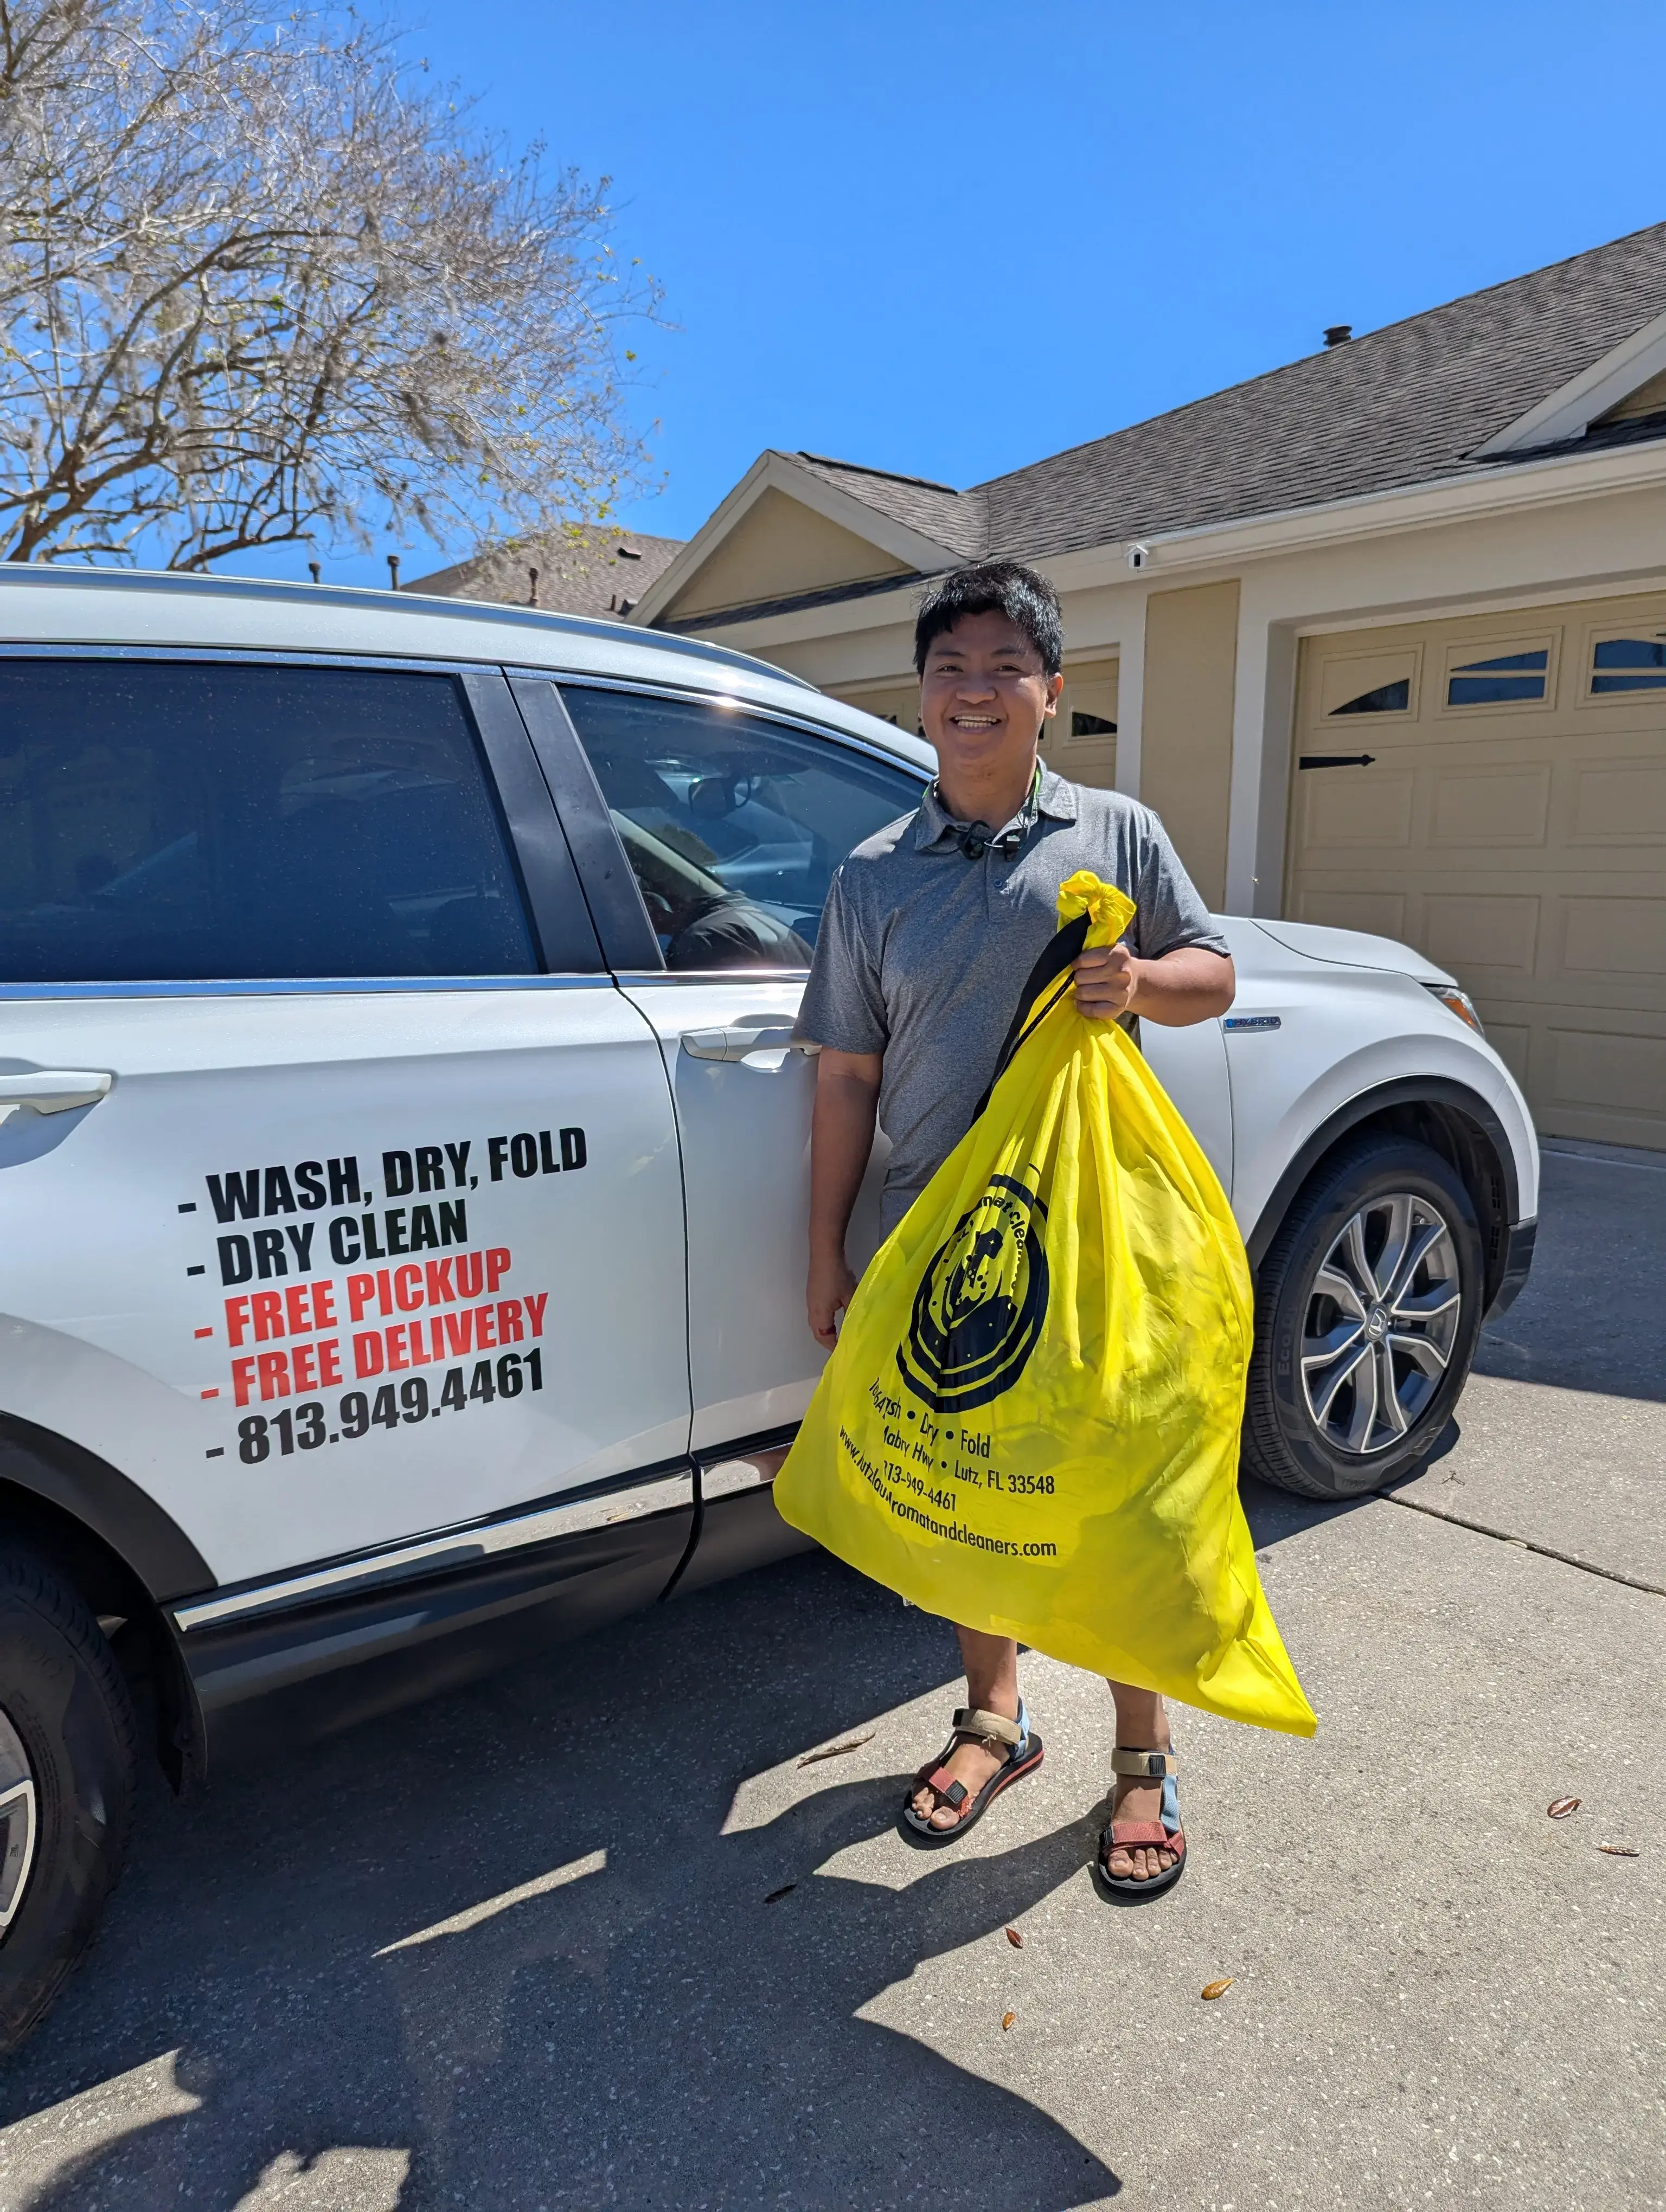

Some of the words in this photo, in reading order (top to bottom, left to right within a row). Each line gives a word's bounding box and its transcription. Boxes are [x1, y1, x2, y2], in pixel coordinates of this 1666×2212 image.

[206, 1156, 372, 1224] WASH,
[382, 1141, 478, 1198] DRY,
[488, 1127, 587, 1182] FOLD
[217, 1222, 315, 1287] DRY
[329, 1199, 467, 1265] CLEAN
[225, 1280, 337, 1347] FREE
[347, 1247, 511, 1323] PICKUP
[231, 1338, 343, 1407] FREE
[353, 1293, 548, 1379] DELIVERY
[238, 1347, 543, 1464] 813.949.4461
[920, 1412, 939, 1446] Dry
[961, 1429, 991, 1458] Fold
[912, 1442, 934, 1472] Hwy
[954, 1459, 982, 1489] Lutz,
[988, 1469, 1004, 1491] FL
[1008, 1474, 1055, 1494] 33548
